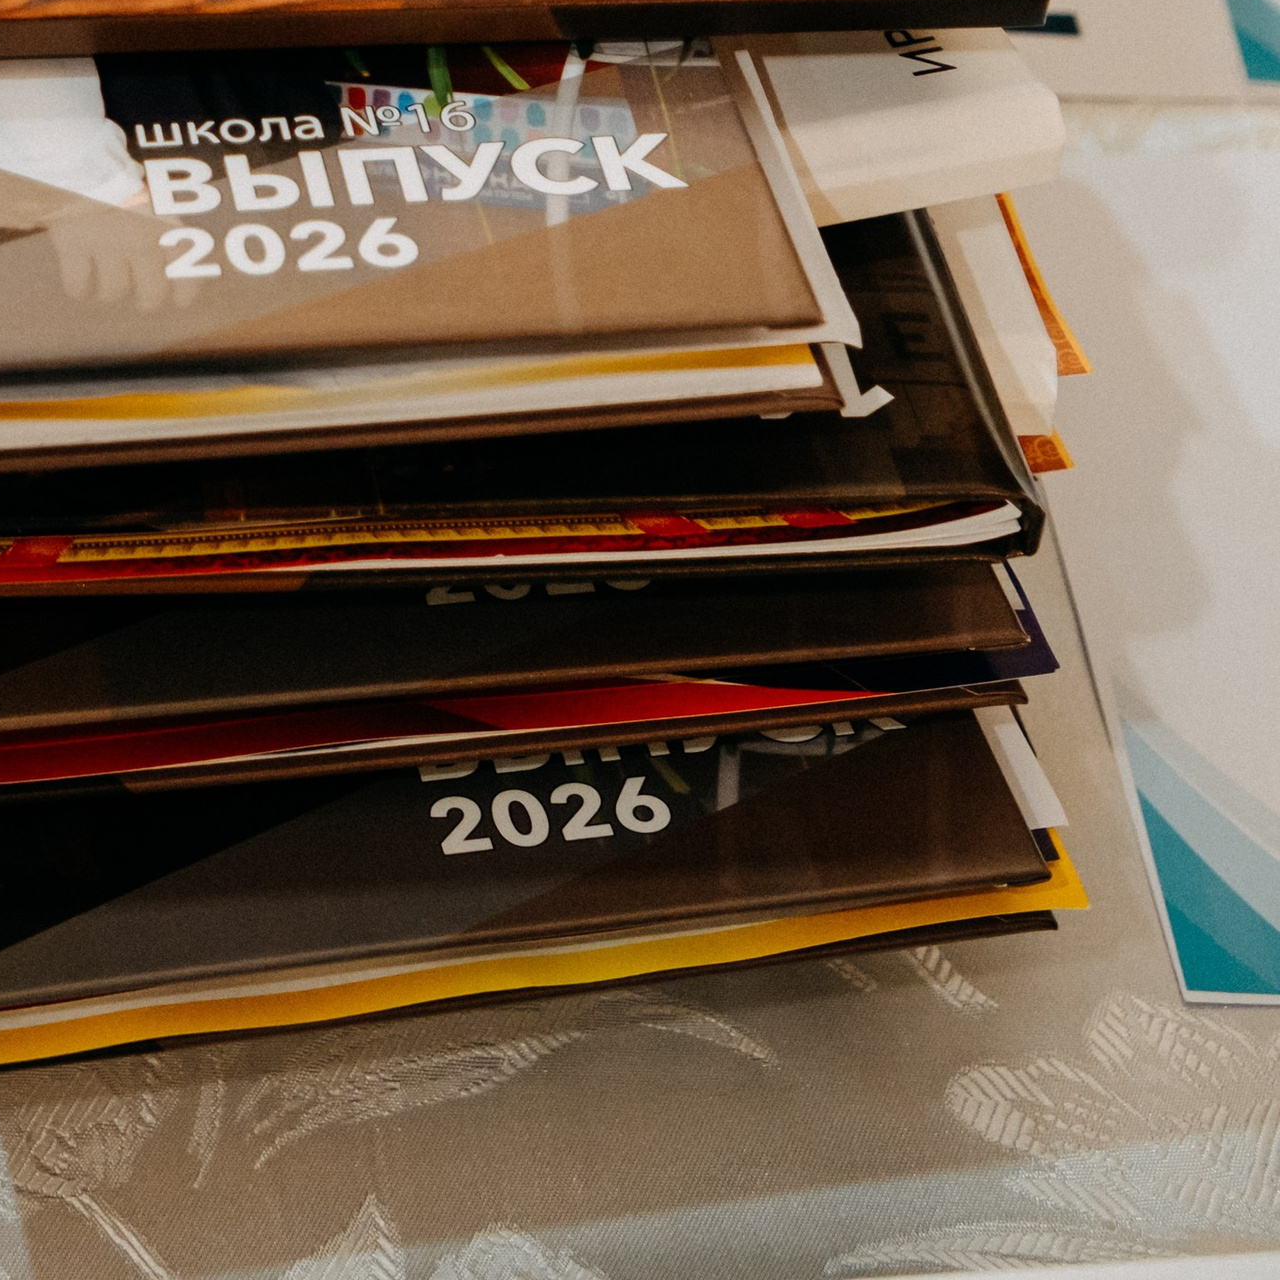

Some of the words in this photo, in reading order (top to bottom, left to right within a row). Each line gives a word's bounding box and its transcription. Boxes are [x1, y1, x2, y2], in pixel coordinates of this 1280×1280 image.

[134, 114, 325, 150] школа
[340, 100, 478, 139] №16
[141, 131, 690, 216] ВЫПУСК
[158, 216, 420, 280] 2026
[429, 776, 672, 856] 2026
